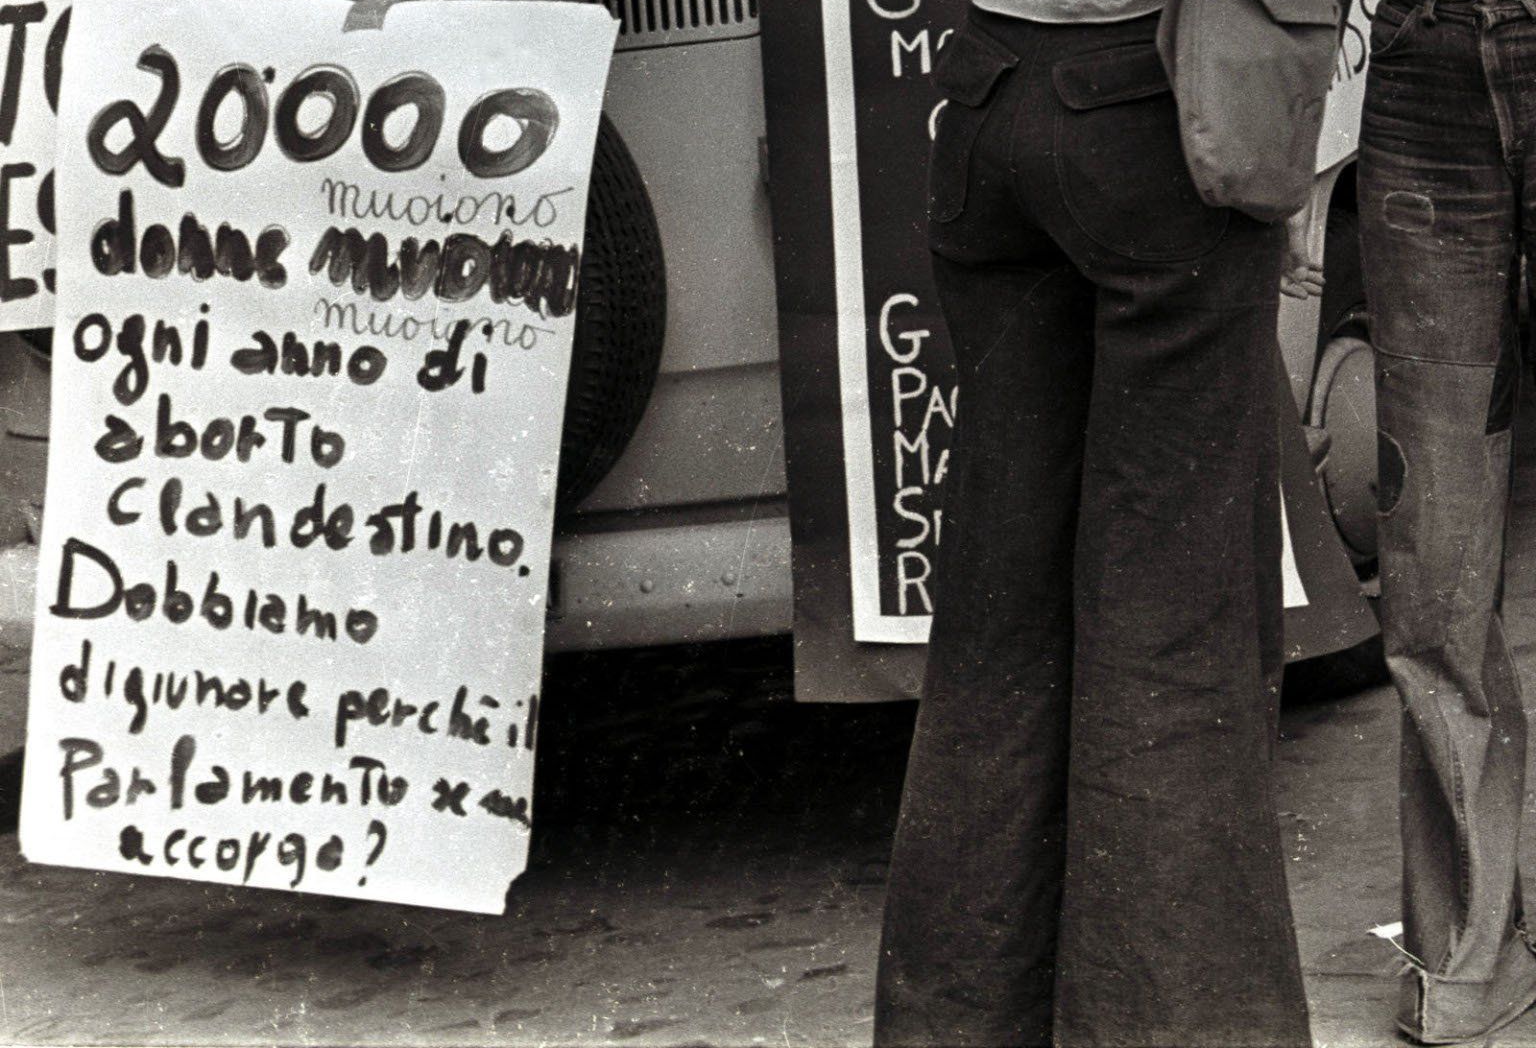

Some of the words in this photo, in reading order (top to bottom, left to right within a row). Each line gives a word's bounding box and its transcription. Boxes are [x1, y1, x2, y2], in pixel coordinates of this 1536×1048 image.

[91, 188, 290, 288] donne
[73, 303, 210, 406] ogni
[230, 330, 388, 386] anno
[417, 319, 488, 393] di
[50, 537, 379, 644] Dobbiamo
[507, 694, 538, 750] il
